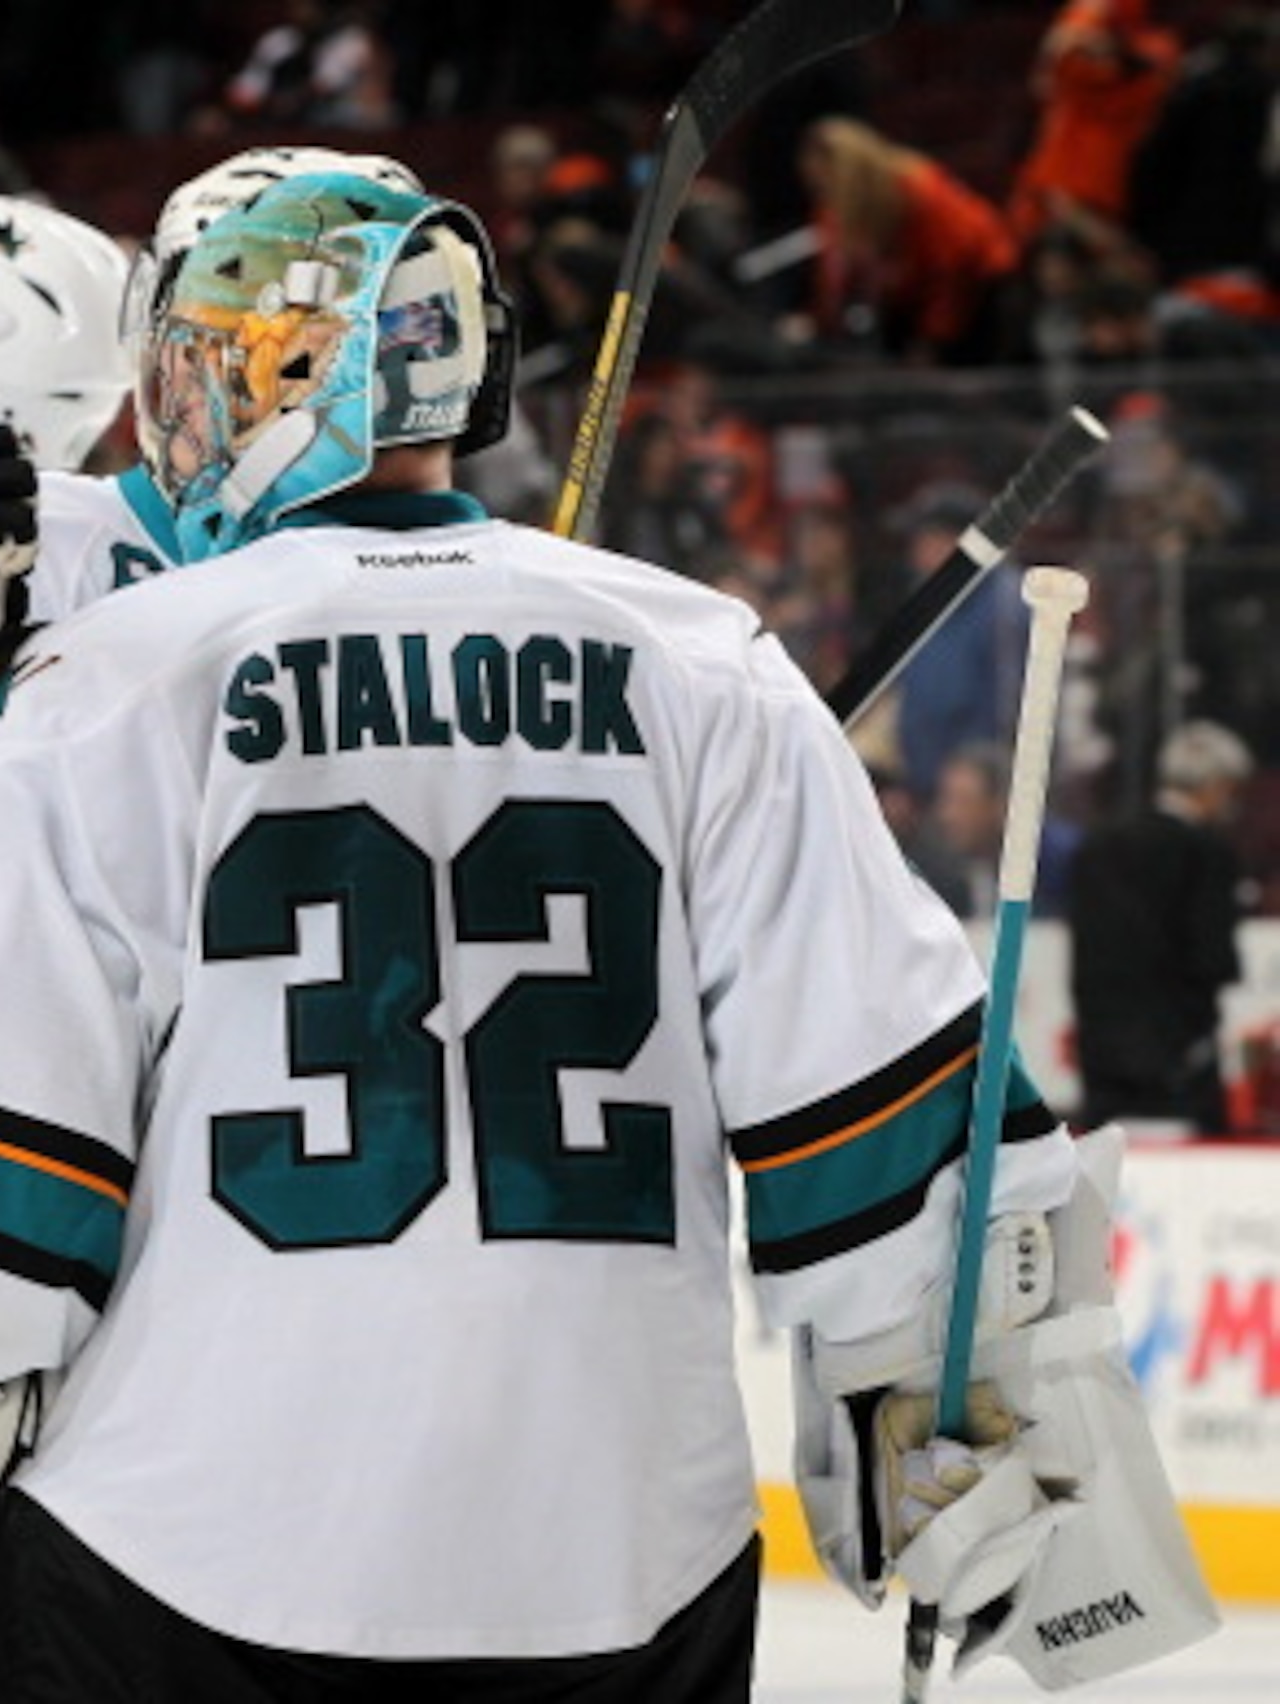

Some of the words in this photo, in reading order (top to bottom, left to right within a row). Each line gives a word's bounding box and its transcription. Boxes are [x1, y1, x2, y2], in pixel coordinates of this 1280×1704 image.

[356, 549, 473, 568] Reebok
[223, 633, 647, 764] STALOCK
[202, 795, 677, 1252] 32
[1035, 1589, 1144, 1651] VAUGHN
